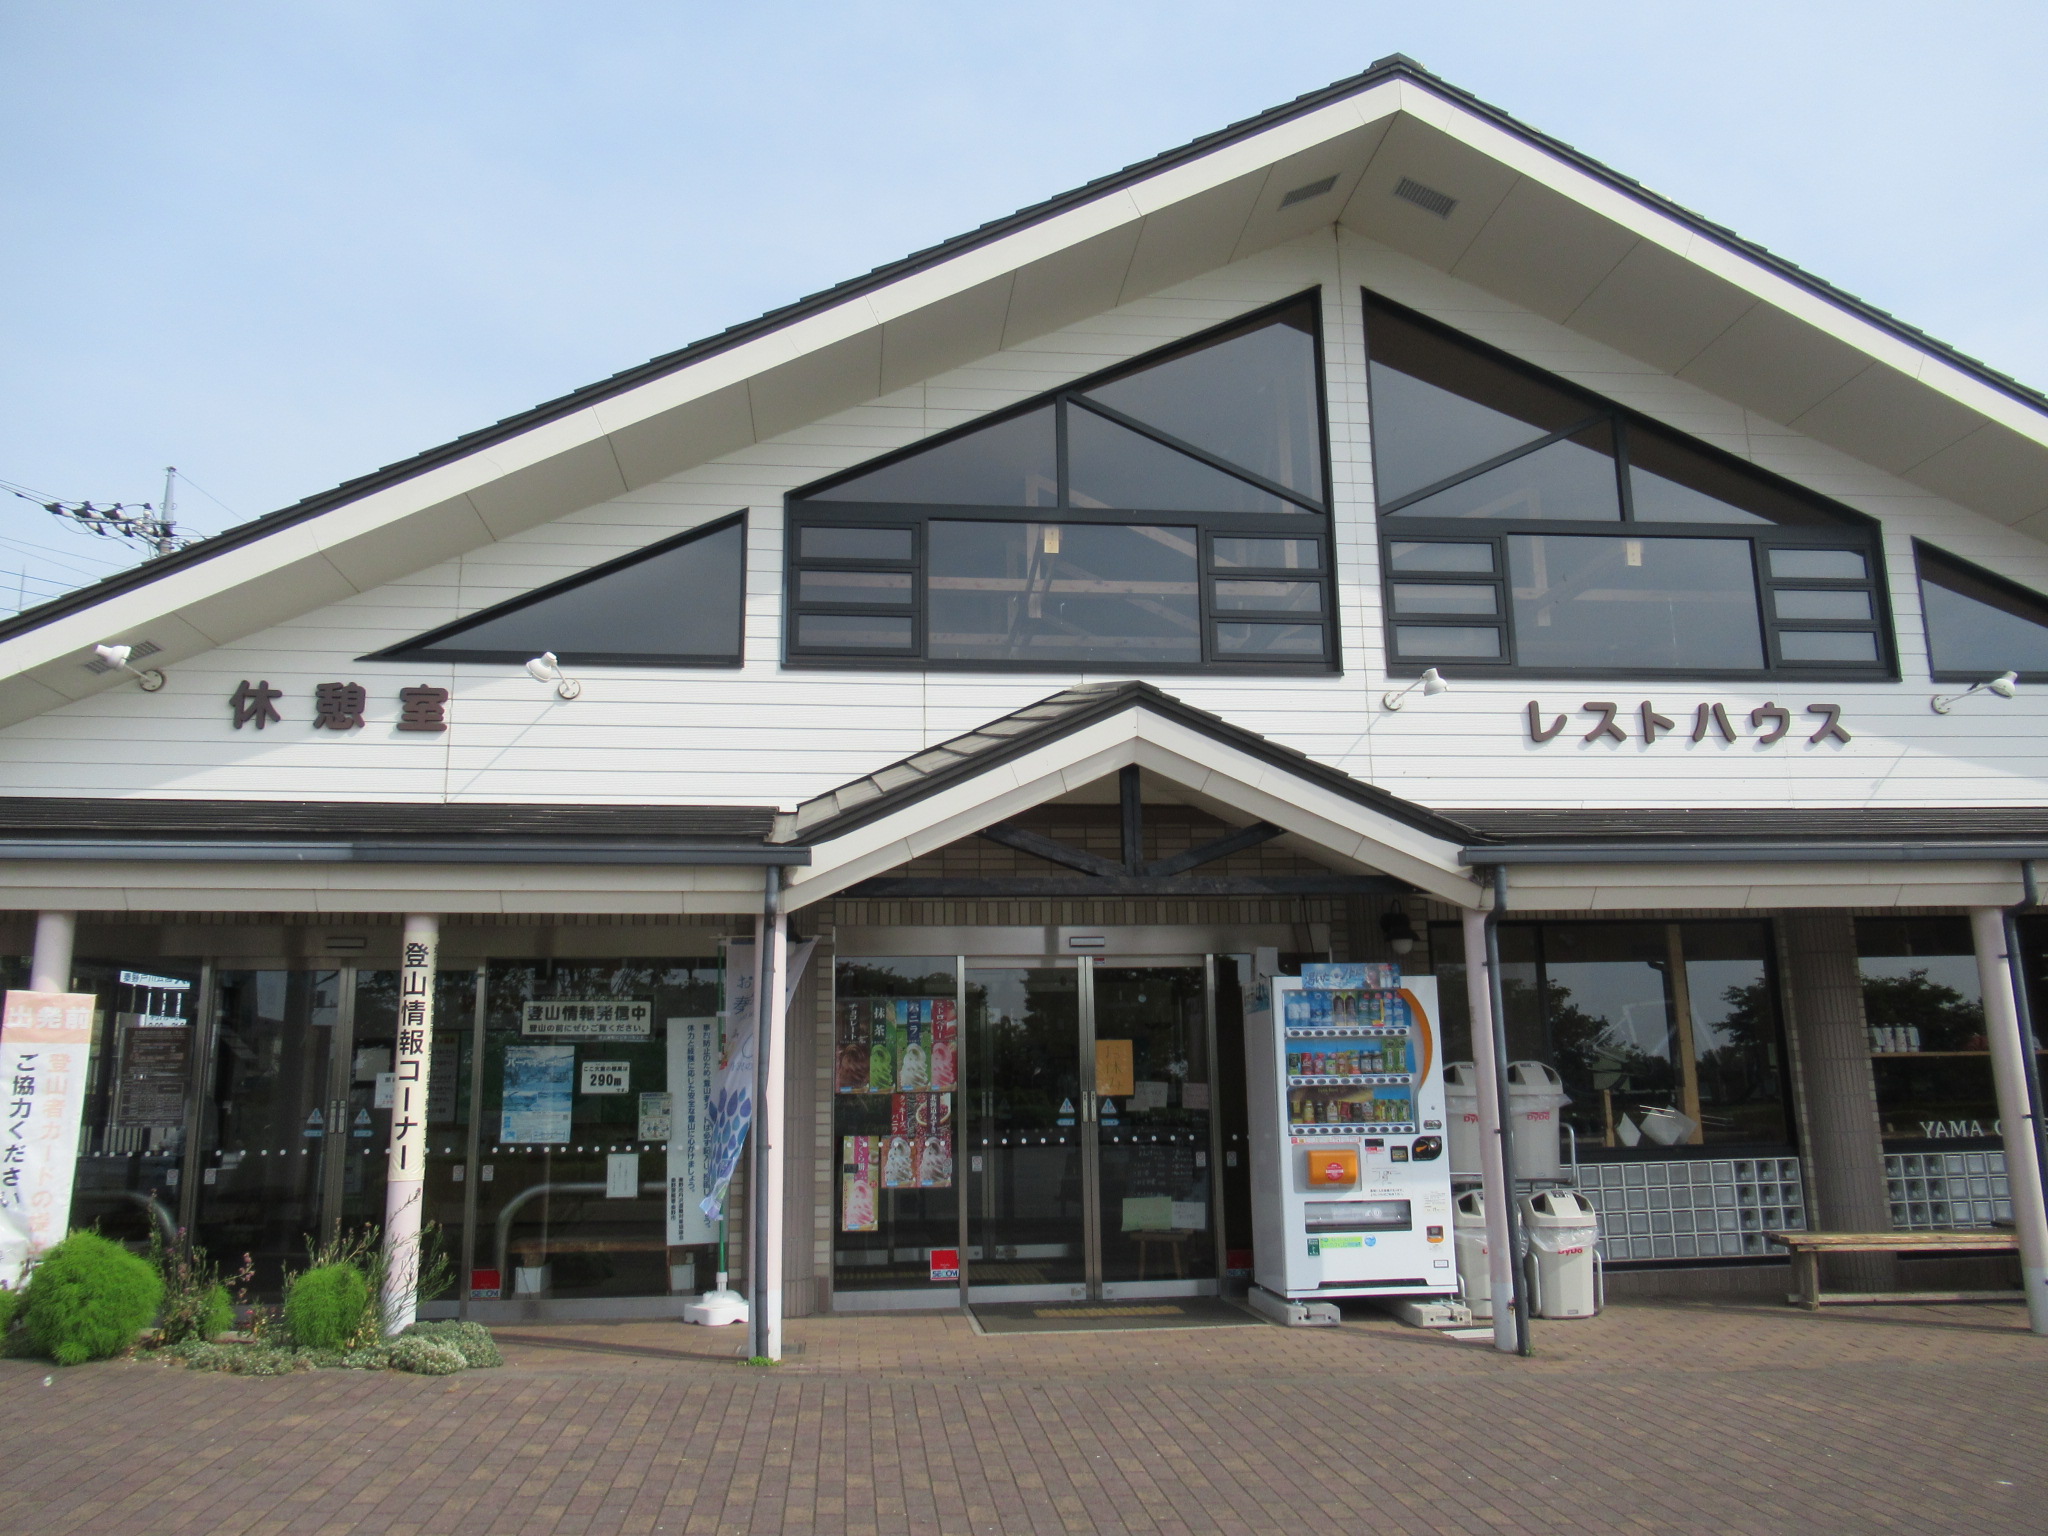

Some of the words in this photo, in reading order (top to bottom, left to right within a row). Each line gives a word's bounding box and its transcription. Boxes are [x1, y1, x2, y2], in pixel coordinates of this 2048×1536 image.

[229, 680, 449, 731] 休憩室
[1527, 700, 1851, 743] レストハウス
[7, 1005, 90, 1029] 出発前
[527, 1004, 646, 1021] 登山情報発信中
[874, 1007, 885, 1036] 抹茶
[908, 1001, 920, 1033] バニラ
[936, 1002, 944, 1039] ストロベリー
[395, 943, 429, 1170] 登山情報コーナー
[590, 1073, 622, 1087] 290m
[1920, 1120, 1985, 1139] YAMA
[932, 1270, 958, 1278] SECOM
